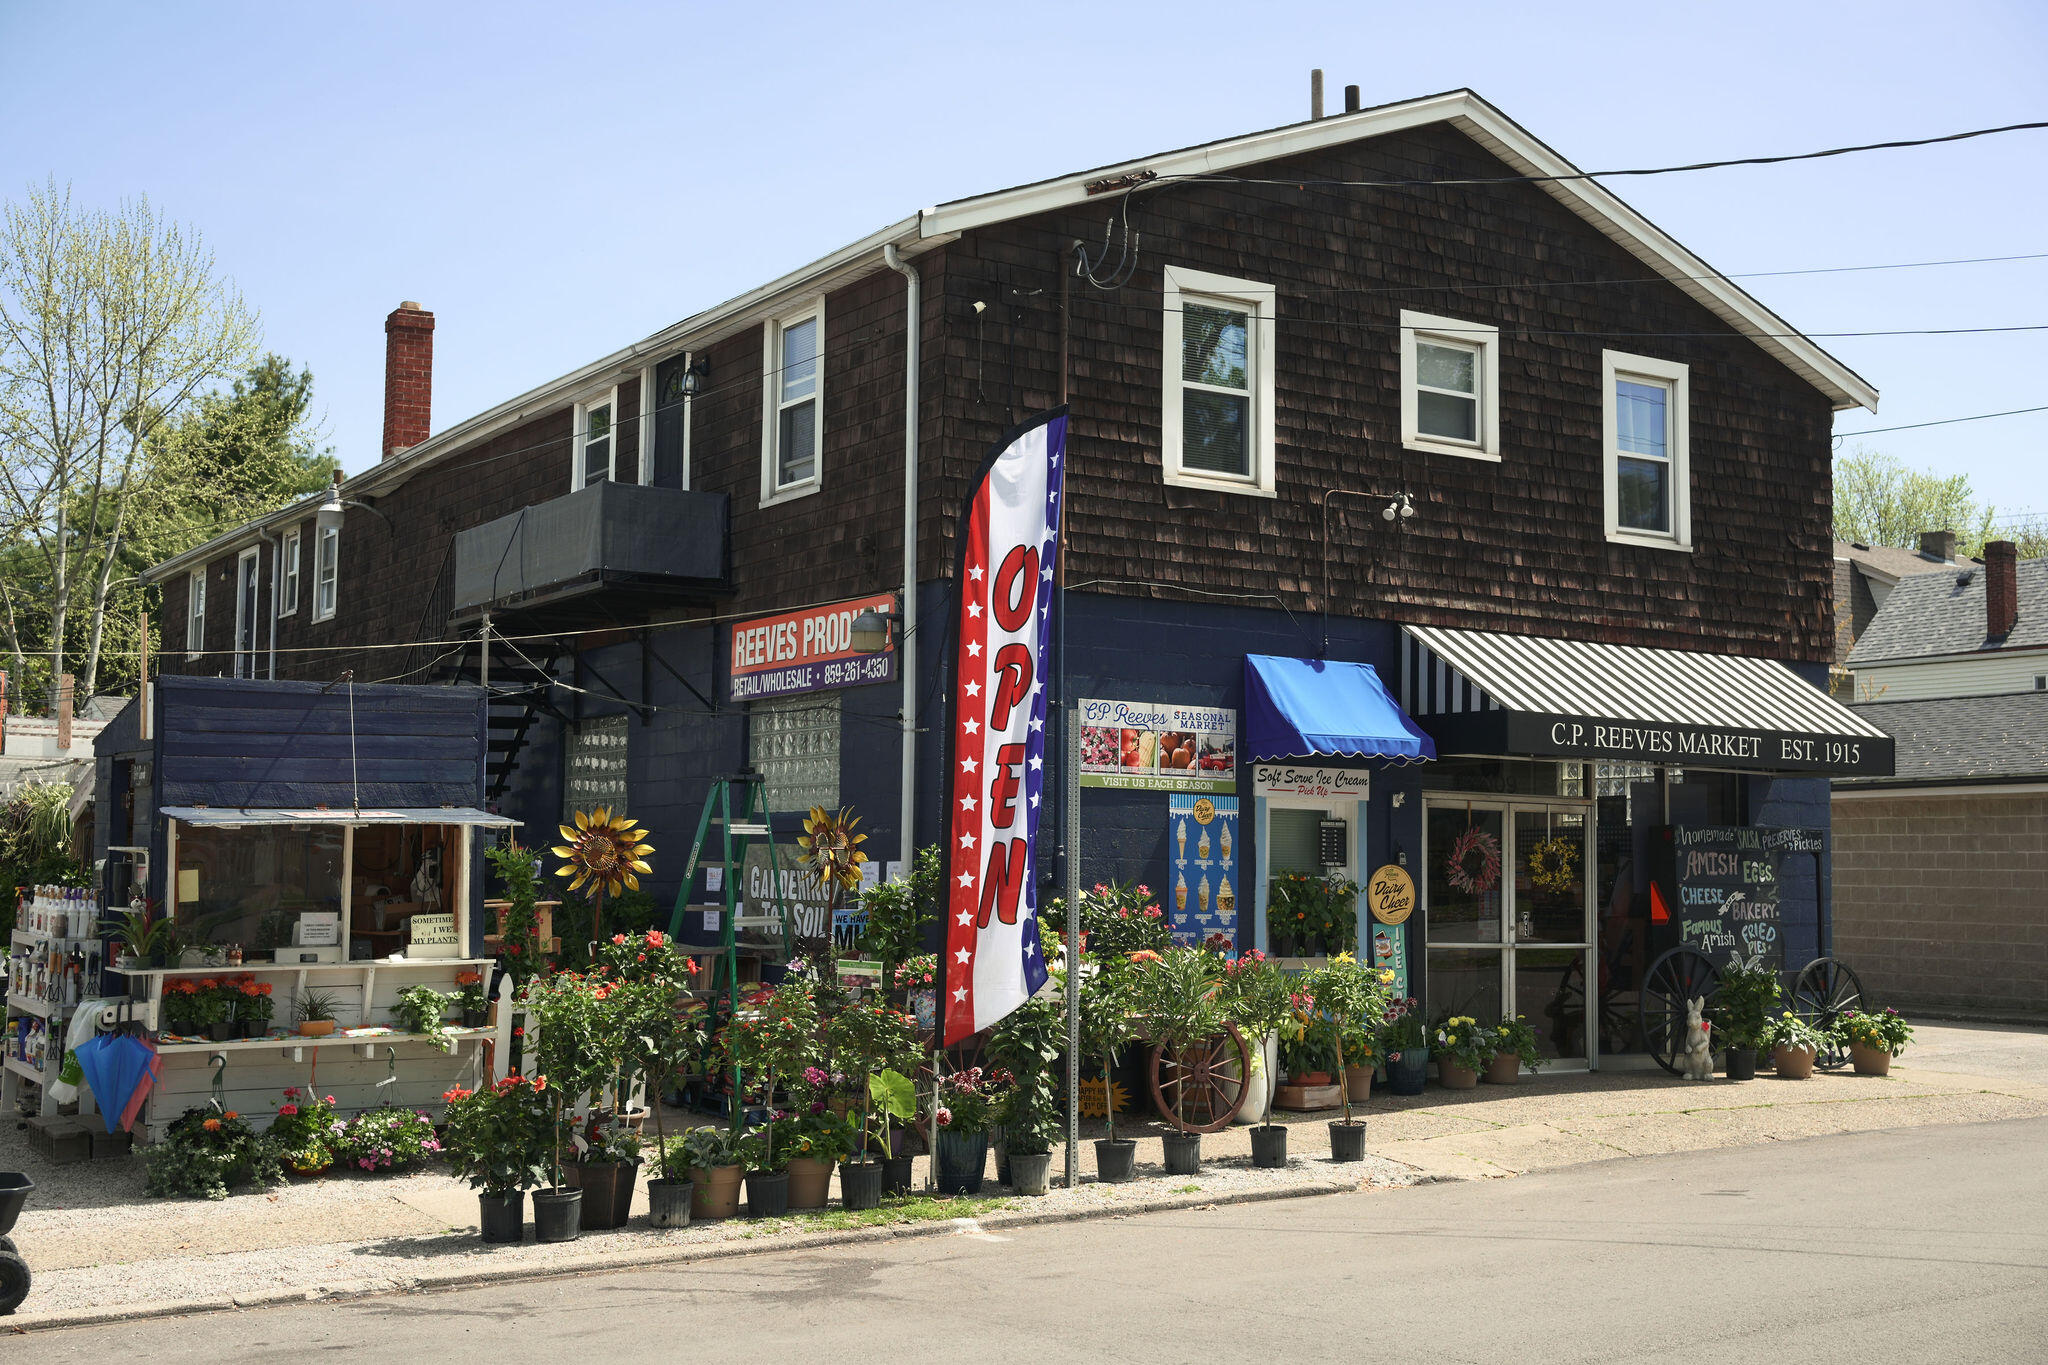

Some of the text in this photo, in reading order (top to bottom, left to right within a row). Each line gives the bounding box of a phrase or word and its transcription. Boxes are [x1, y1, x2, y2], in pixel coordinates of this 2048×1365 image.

[735, 603, 890, 668] REEVES PROD
[733, 657, 889, 697] RETAIL/WHOLESALE 859-261-4350
[1113, 703, 1168, 727] Reeves
[1173, 710, 1231, 723] SEASONAL
[1180, 720, 1225, 731] MARKET
[976, 543, 1040, 930] OPEN
[1551, 722, 1861, 765] C.P. REEVES MARKET EST. 1915
[1102, 776, 1214, 791] VISIT US EACH SEASON
[1257, 768, 1368, 788] Soft Serve Ice Cream
[1297, 785, 1328, 797] Pick Up
[1683, 851, 1738, 880] AMISH
[1375, 881, 1406, 897] Dairy
[1681, 886, 1725, 905] CHEESE
[1380, 895, 1409, 910] Cheer
[793, 902, 827, 938] SOIL
[836, 914, 848, 923] WE
[427, 936, 459, 945] PLANTS
[1701, 930, 1736, 953] Amish
[1741, 922, 1776, 943] FRIED
[1393, 927, 1403, 969] ICE
